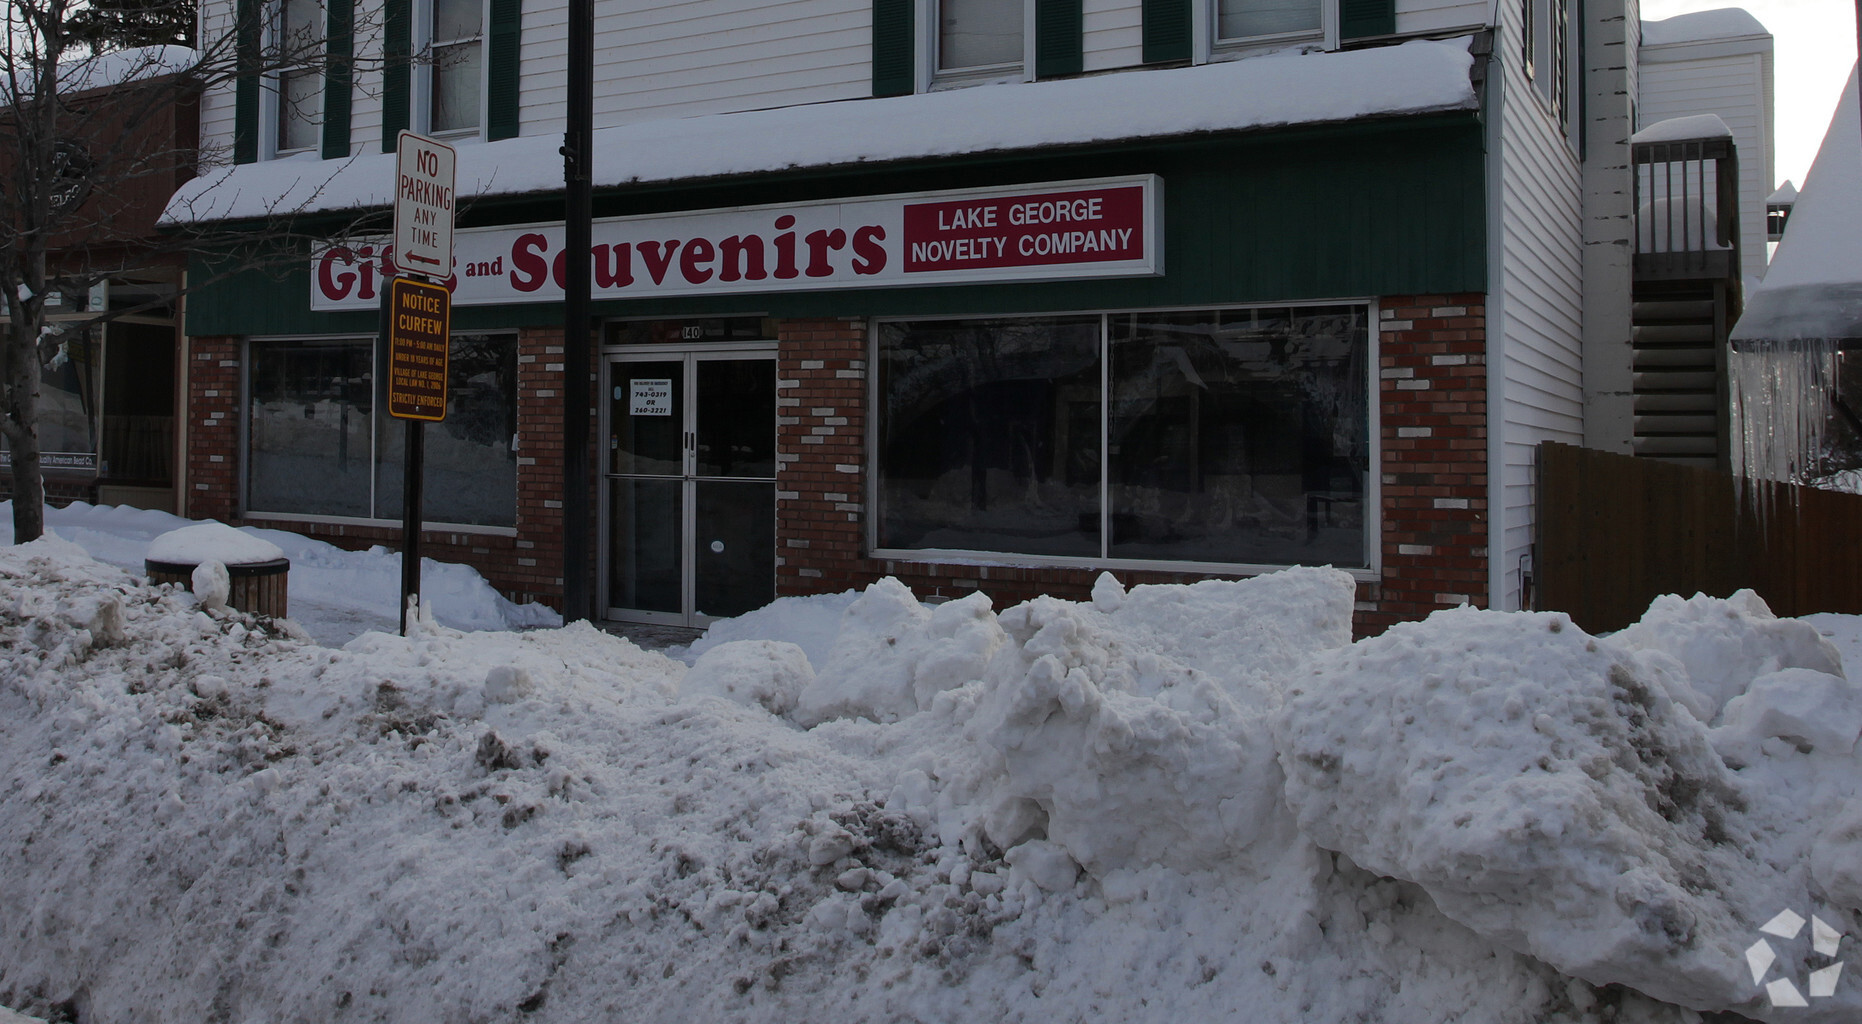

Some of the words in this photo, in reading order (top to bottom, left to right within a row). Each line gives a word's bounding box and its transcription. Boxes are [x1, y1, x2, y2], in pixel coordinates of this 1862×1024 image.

[417, 148, 438, 178] NO
[401, 174, 451, 210] PARKING
[414, 207, 437, 226] ANY
[938, 206, 998, 231] LAKE
[1008, 197, 1103, 226] GEORGE
[411, 227, 438, 248] TIME
[911, 236, 1008, 263] NOVELTY
[1018, 228, 1133, 257] COMPANY
[466, 256, 503, 277] and
[510, 215, 887, 292] Suvenirs
[402, 292, 441, 314] NOTICE
[399, 314, 443, 335] CURFEW
[684, 328, 699, 337] 140
[394, 368, 410, 376] VILLAGE
[392, 392, 416, 404] STRICTLY
[416, 395, 443, 407] ENFORCED
